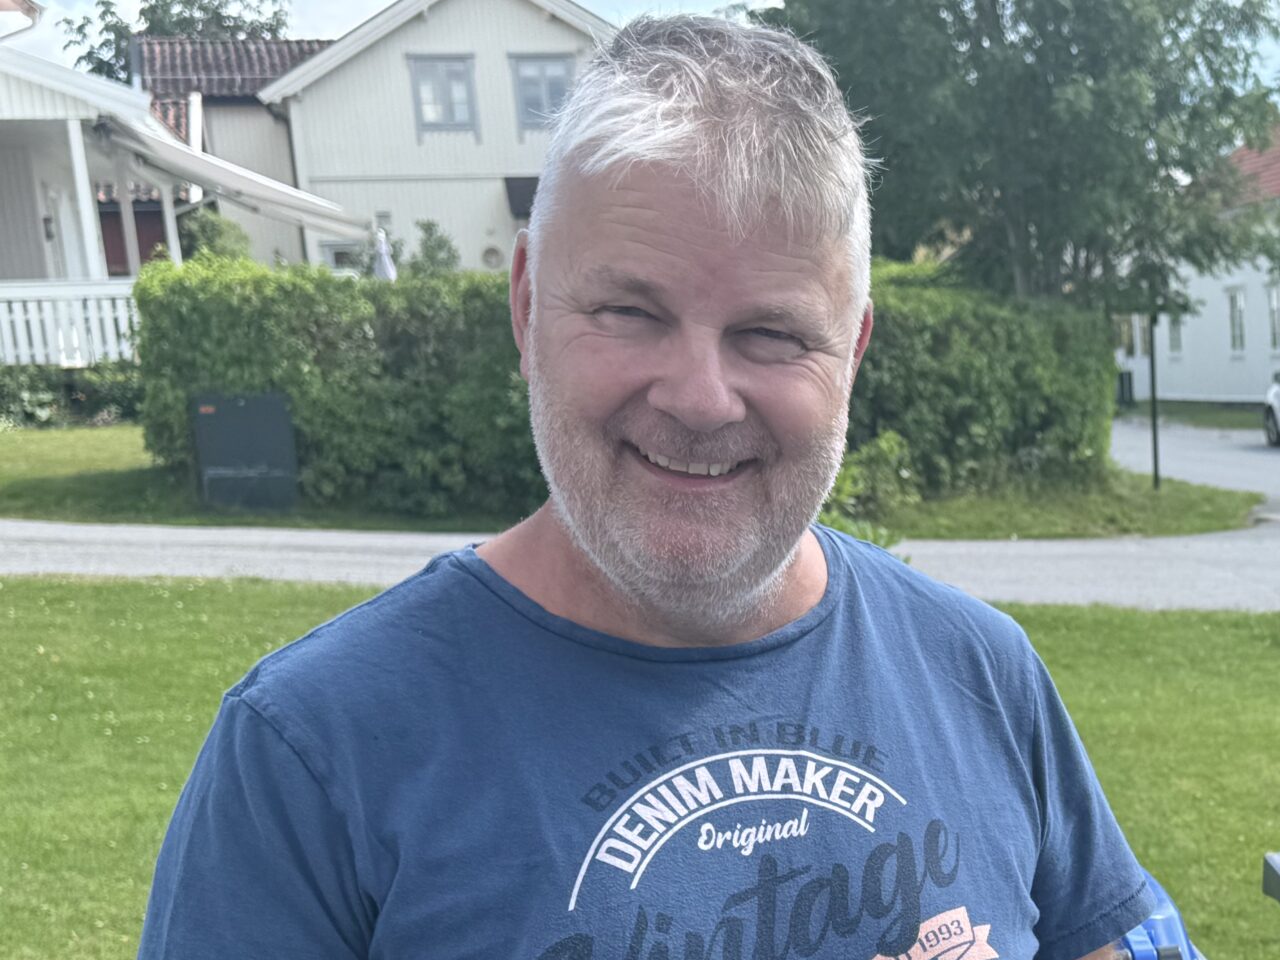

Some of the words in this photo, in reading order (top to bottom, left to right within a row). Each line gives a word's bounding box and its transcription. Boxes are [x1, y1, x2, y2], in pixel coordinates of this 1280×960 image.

[582, 732, 697, 812] BUILT
[712, 722, 760, 748] IN
[776, 721, 888, 771] BLUE
[595, 766, 723, 873] DENIM
[728, 756, 885, 823] MAKER
[697, 808, 810, 856] Original
[918, 918, 965, 954] 1993
